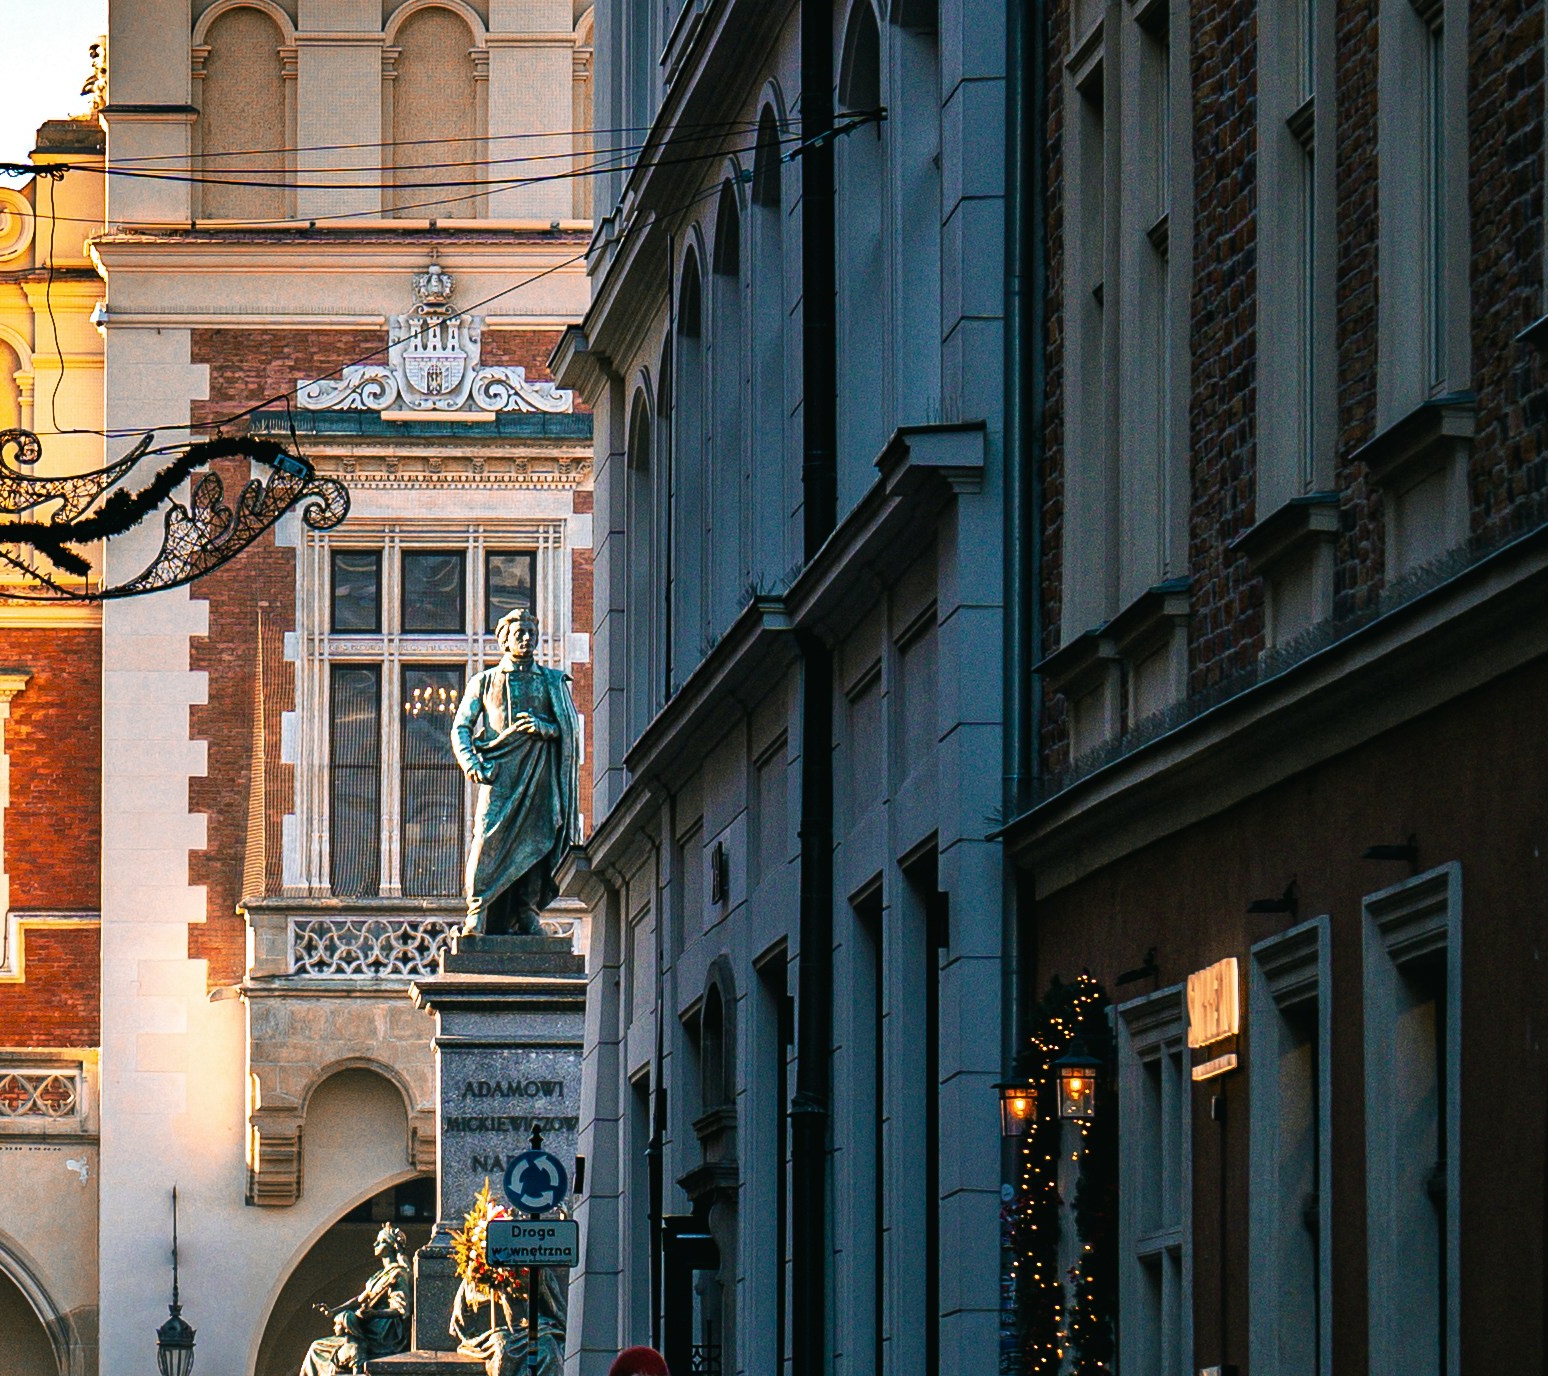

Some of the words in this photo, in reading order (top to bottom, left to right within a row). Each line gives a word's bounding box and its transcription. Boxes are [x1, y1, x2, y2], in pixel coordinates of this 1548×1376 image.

[462, 1080, 565, 1099] ADAMOWI
[511, 1225, 556, 1241] Droga
[491, 1245, 572, 1260] wwnętrzna
